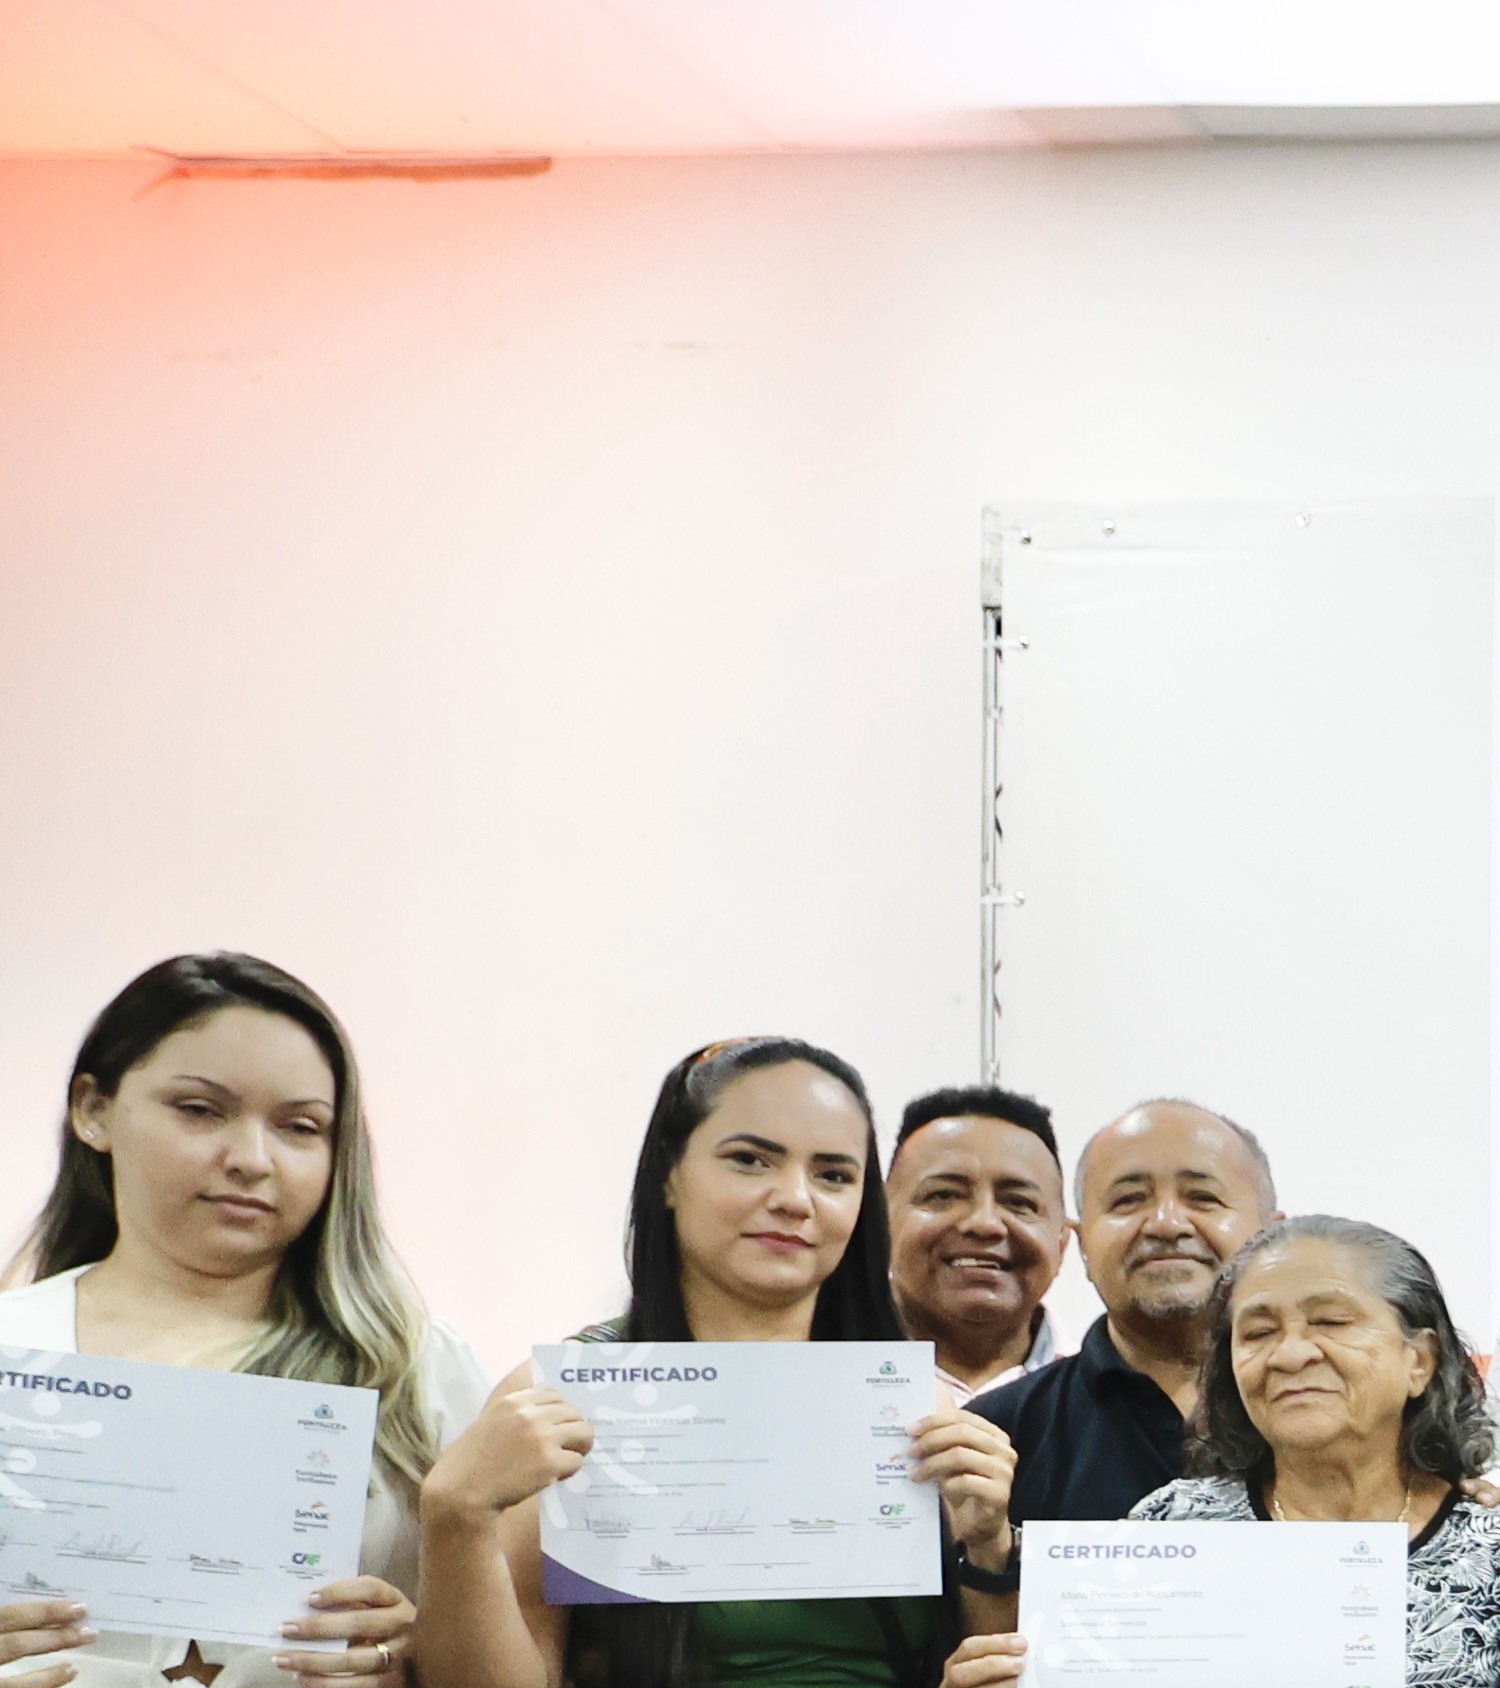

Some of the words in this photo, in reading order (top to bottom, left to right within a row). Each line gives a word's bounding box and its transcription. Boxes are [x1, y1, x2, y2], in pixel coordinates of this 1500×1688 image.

[560, 1366, 718, 1383] CERTIFICADO
[0, 1370, 131, 1400] TIFICADO
[1048, 1544, 1196, 1559] CERTIFICADO
